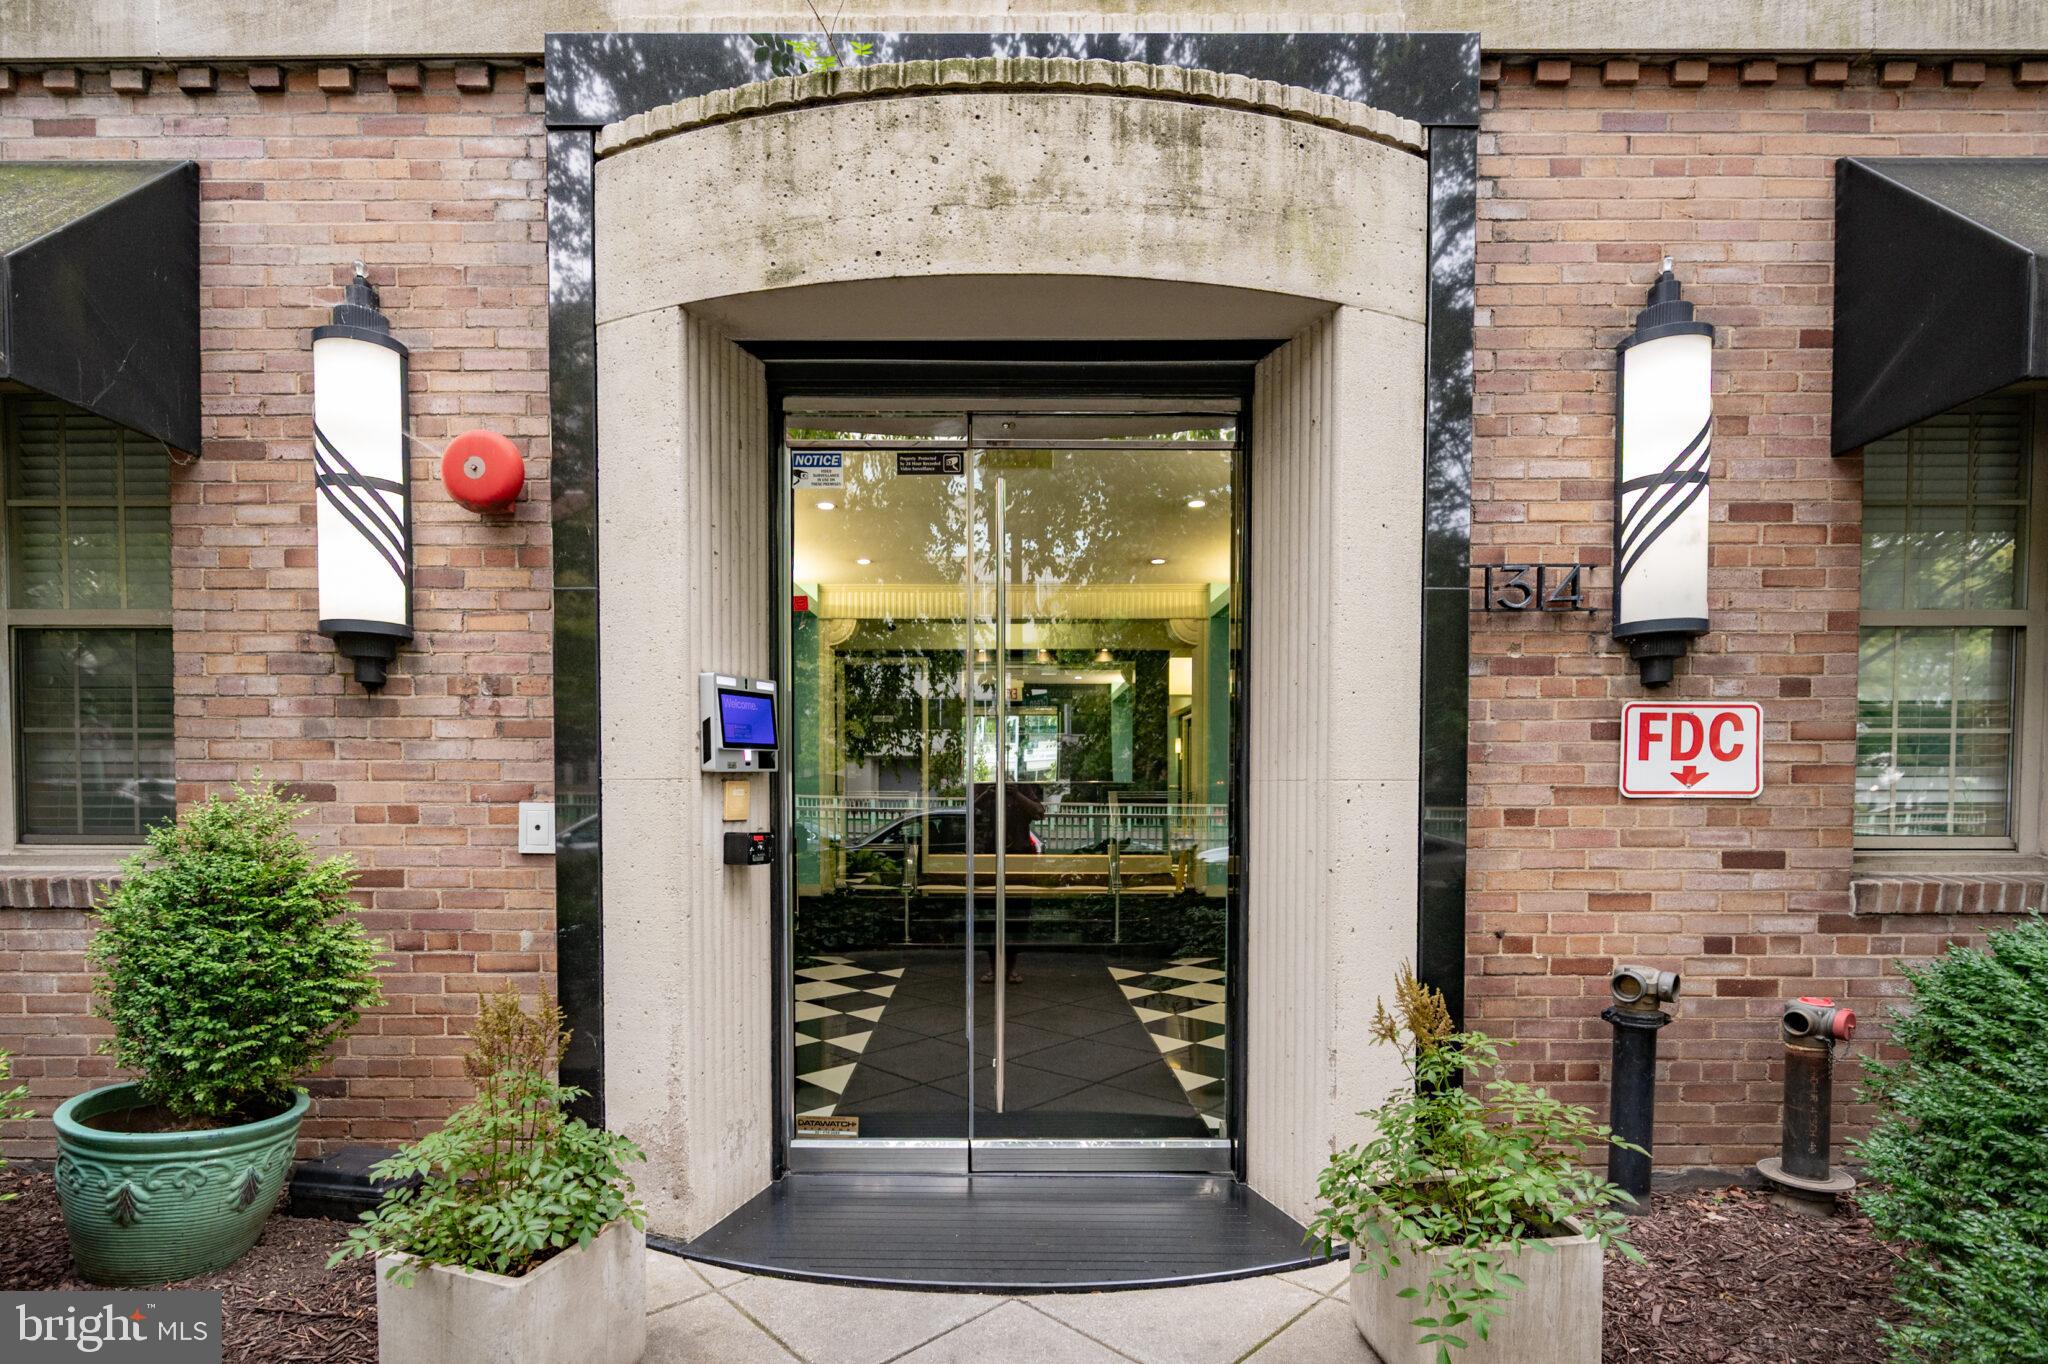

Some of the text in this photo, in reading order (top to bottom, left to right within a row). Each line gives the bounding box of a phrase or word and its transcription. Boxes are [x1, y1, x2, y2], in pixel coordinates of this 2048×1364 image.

[795, 455, 840, 466] NOTICE
[1485, 564, 1584, 611] 1314
[1638, 712, 1744, 762] FDC
[798, 1119, 854, 1128] DATAWATCH
